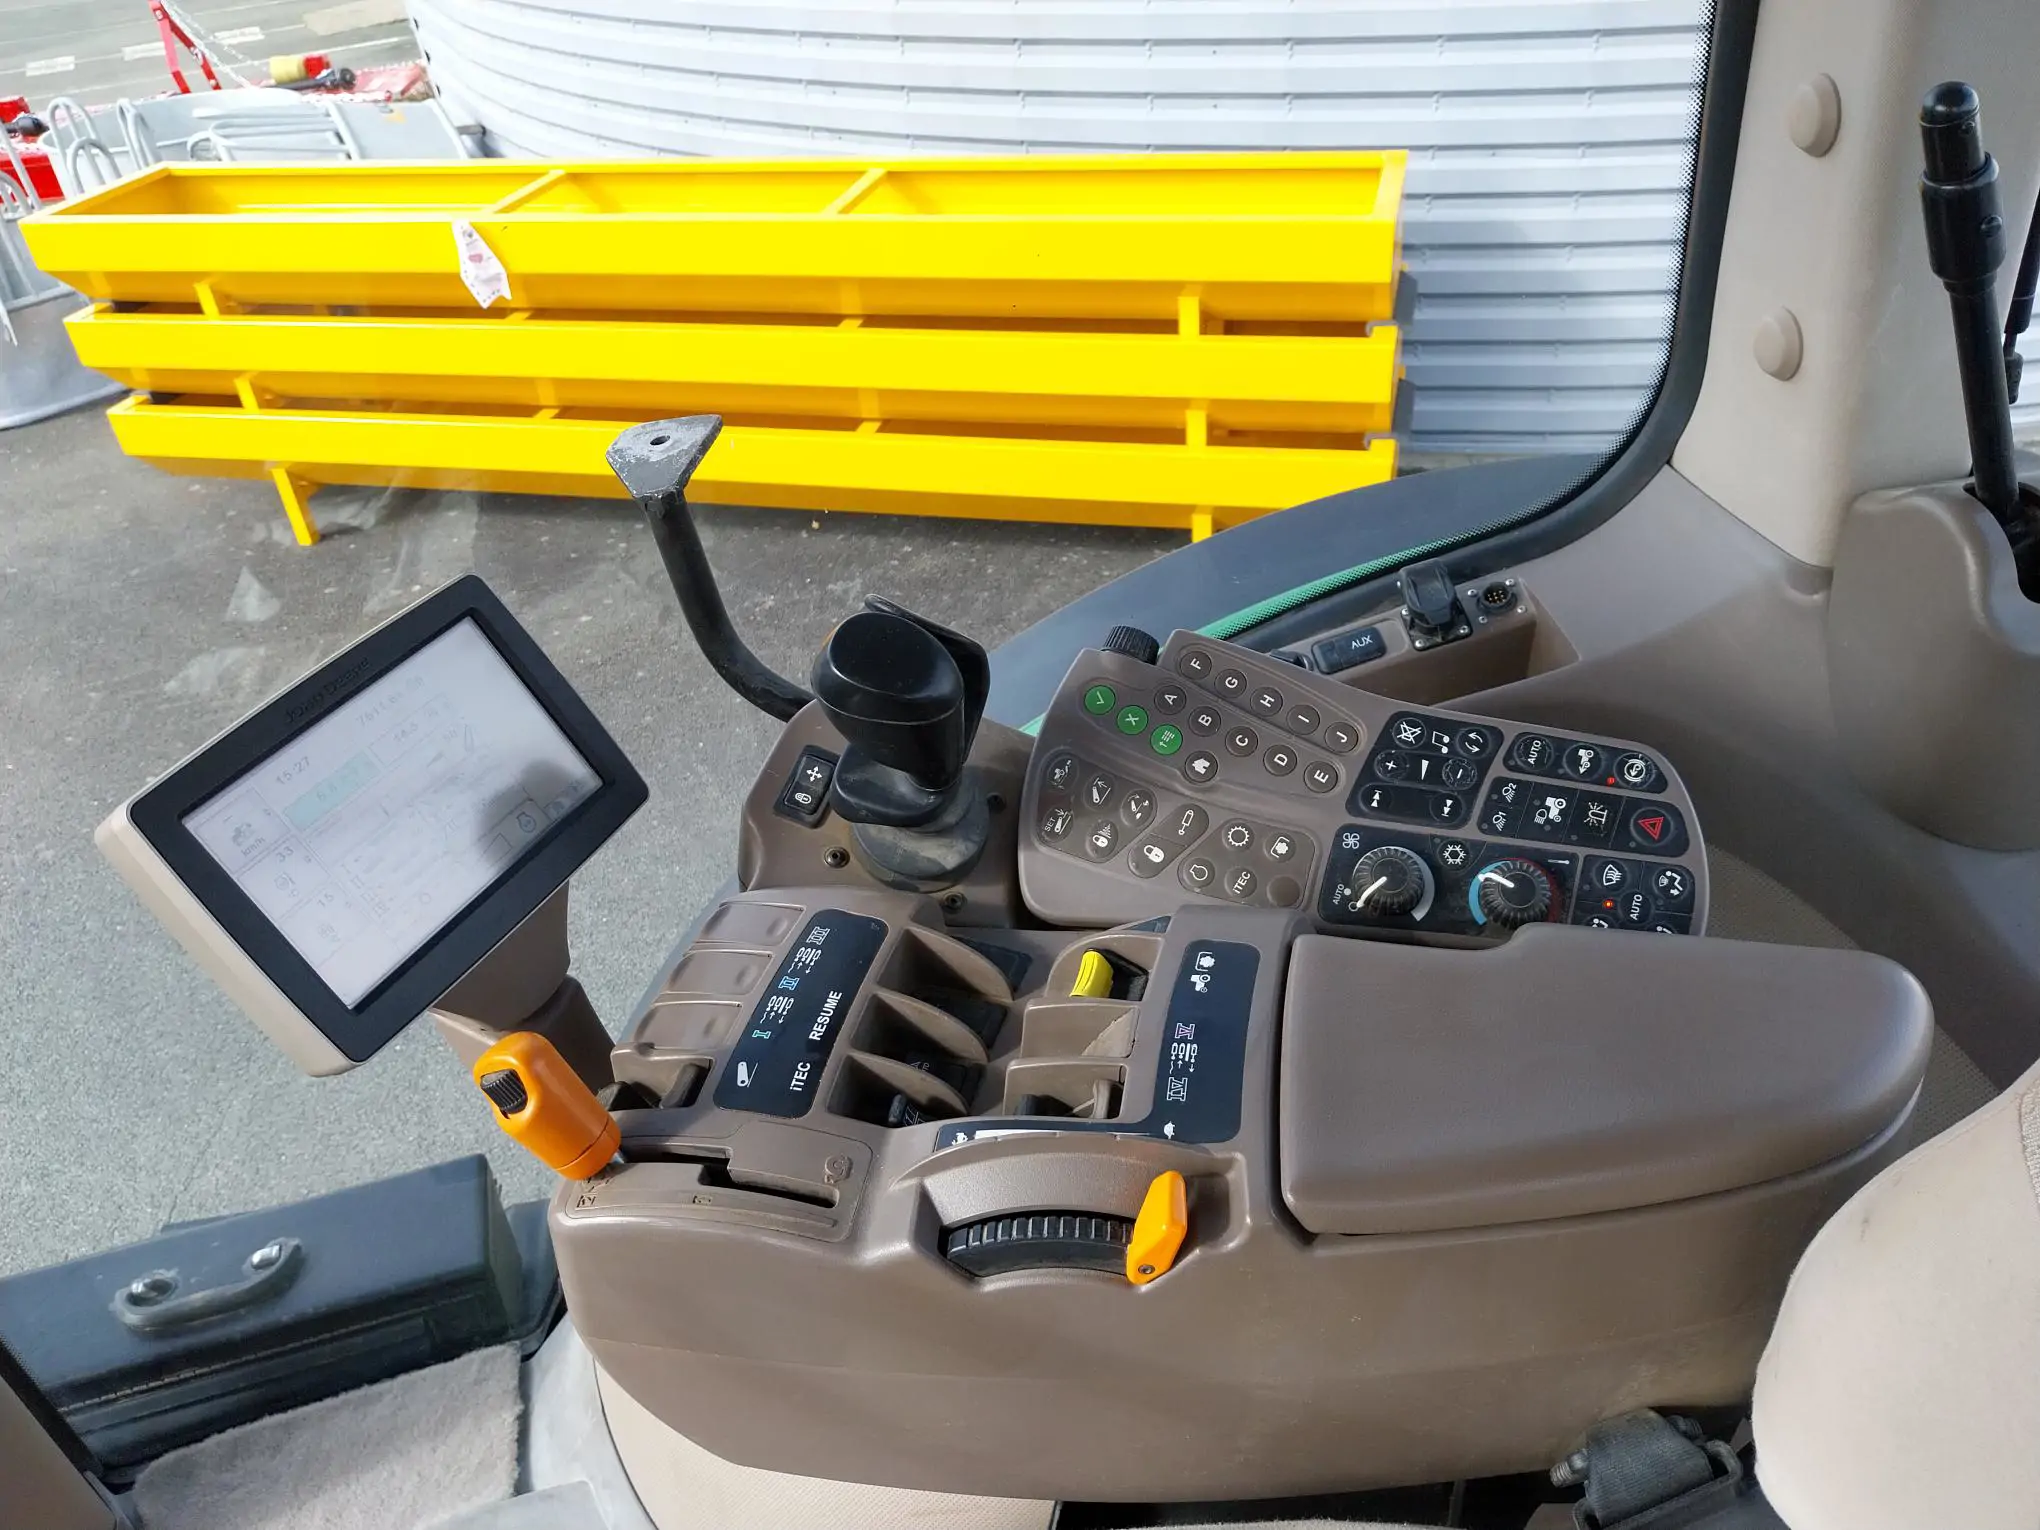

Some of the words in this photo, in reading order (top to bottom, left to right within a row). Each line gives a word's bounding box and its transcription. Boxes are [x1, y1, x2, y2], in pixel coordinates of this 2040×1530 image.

[1351, 635, 1373, 650] AUX
[1190, 658, 1202, 671] F
[1225, 676, 1239, 689] G
[1164, 693, 1178, 705] A
[1259, 694, 1275, 708] H
[1198, 714, 1212, 727] B
[1298, 714, 1310, 723] I
[1235, 734, 1249, 747] C
[1336, 731, 1348, 743] J
[1527, 739, 1542, 765] AUTO
[1273, 753, 1288, 767] D
[1313, 769, 1329, 784] E
[1044, 817, 1057, 832] SET
[274, 846, 294, 862] 33
[1232, 871, 1251, 894] iTEC
[1332, 883, 1345, 905] AUTO
[1629, 894, 1643, 920] AUTO
[809, 990, 843, 1041] RESUME
[789, 1062, 811, 1092] iTEC
